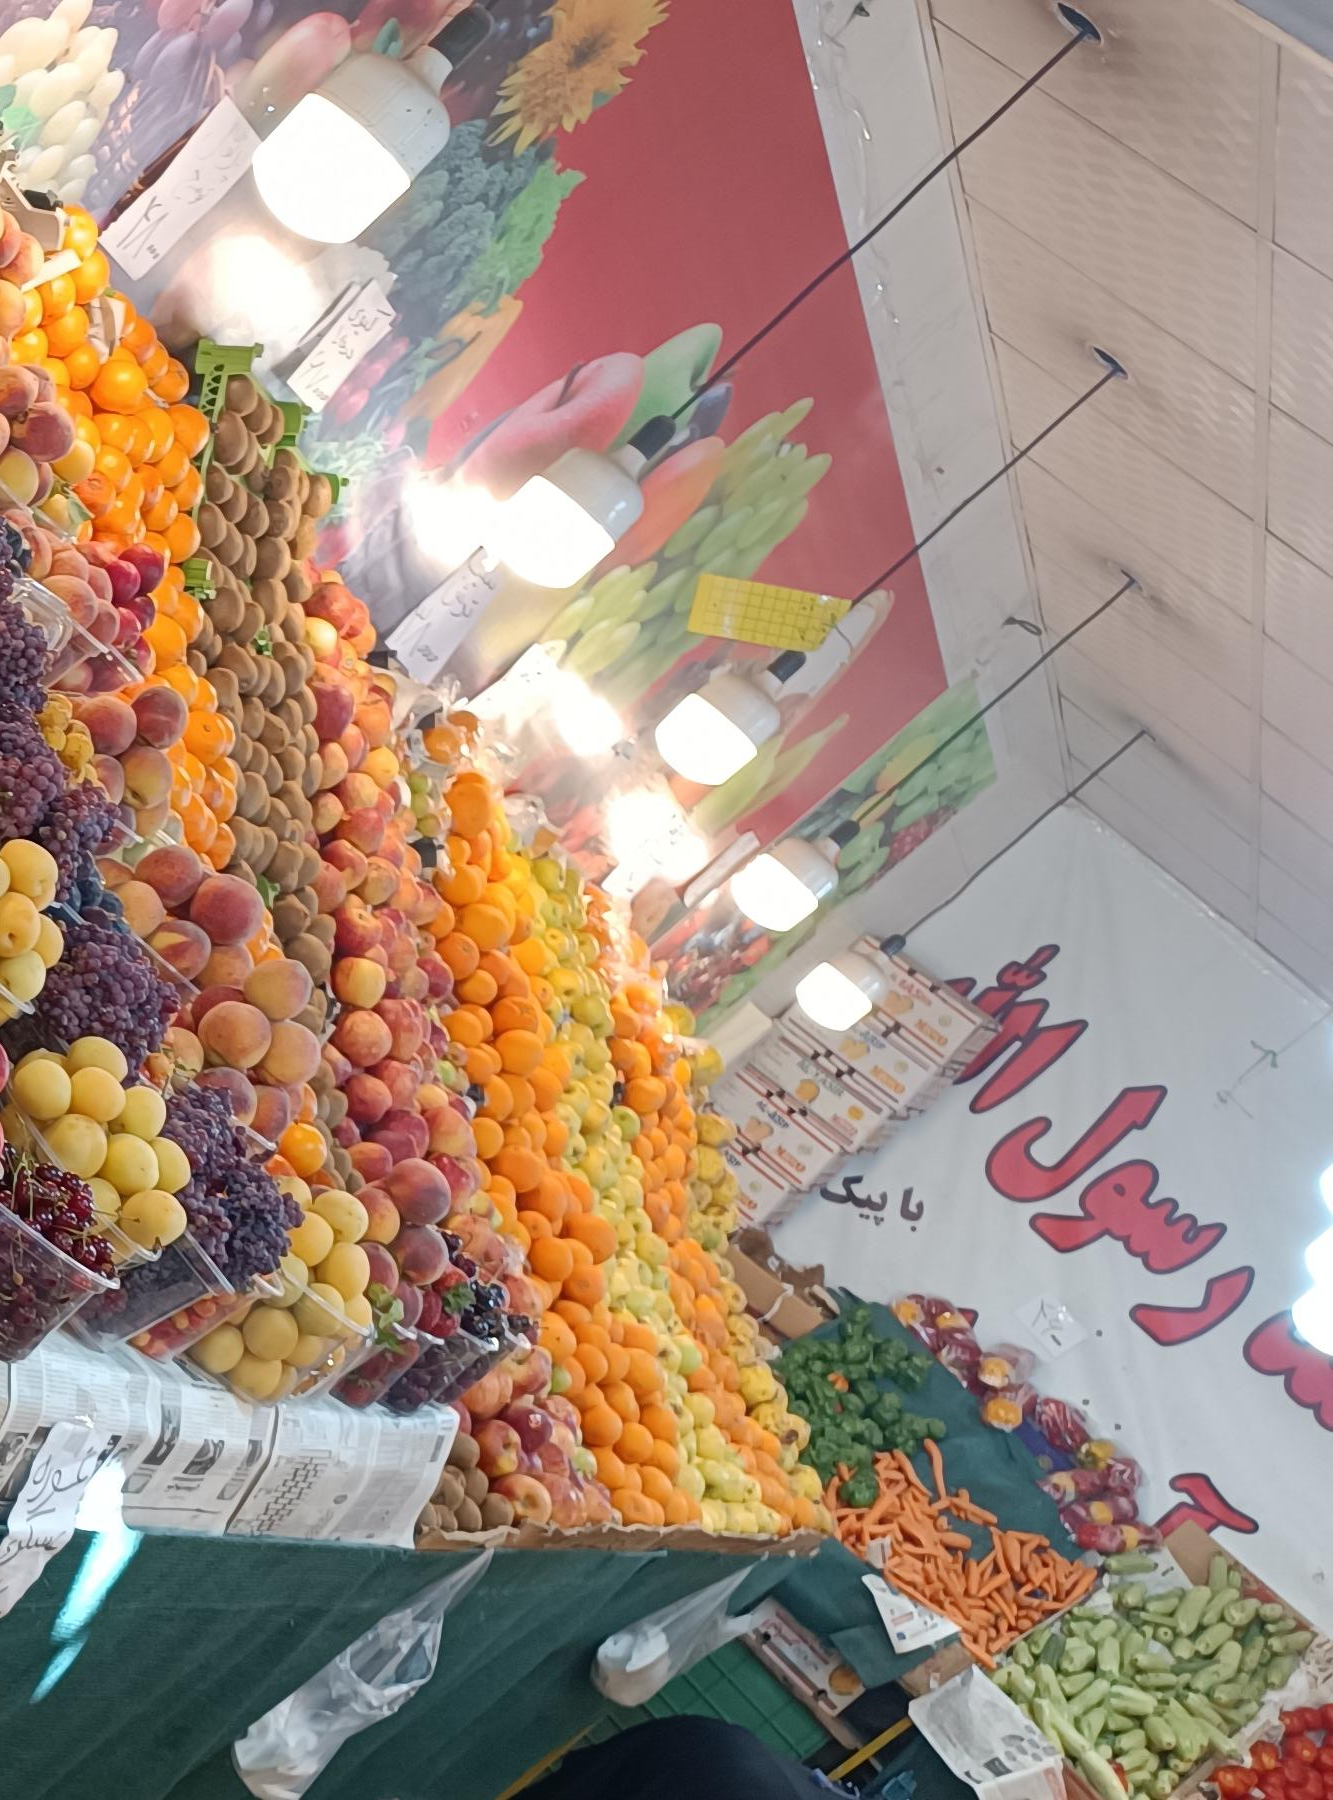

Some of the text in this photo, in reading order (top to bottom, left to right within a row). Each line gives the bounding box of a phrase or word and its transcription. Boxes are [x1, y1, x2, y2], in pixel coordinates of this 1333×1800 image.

[819, 1174, 924, 1232] با پیک
[984, 1084, 1255, 1347] رسول
